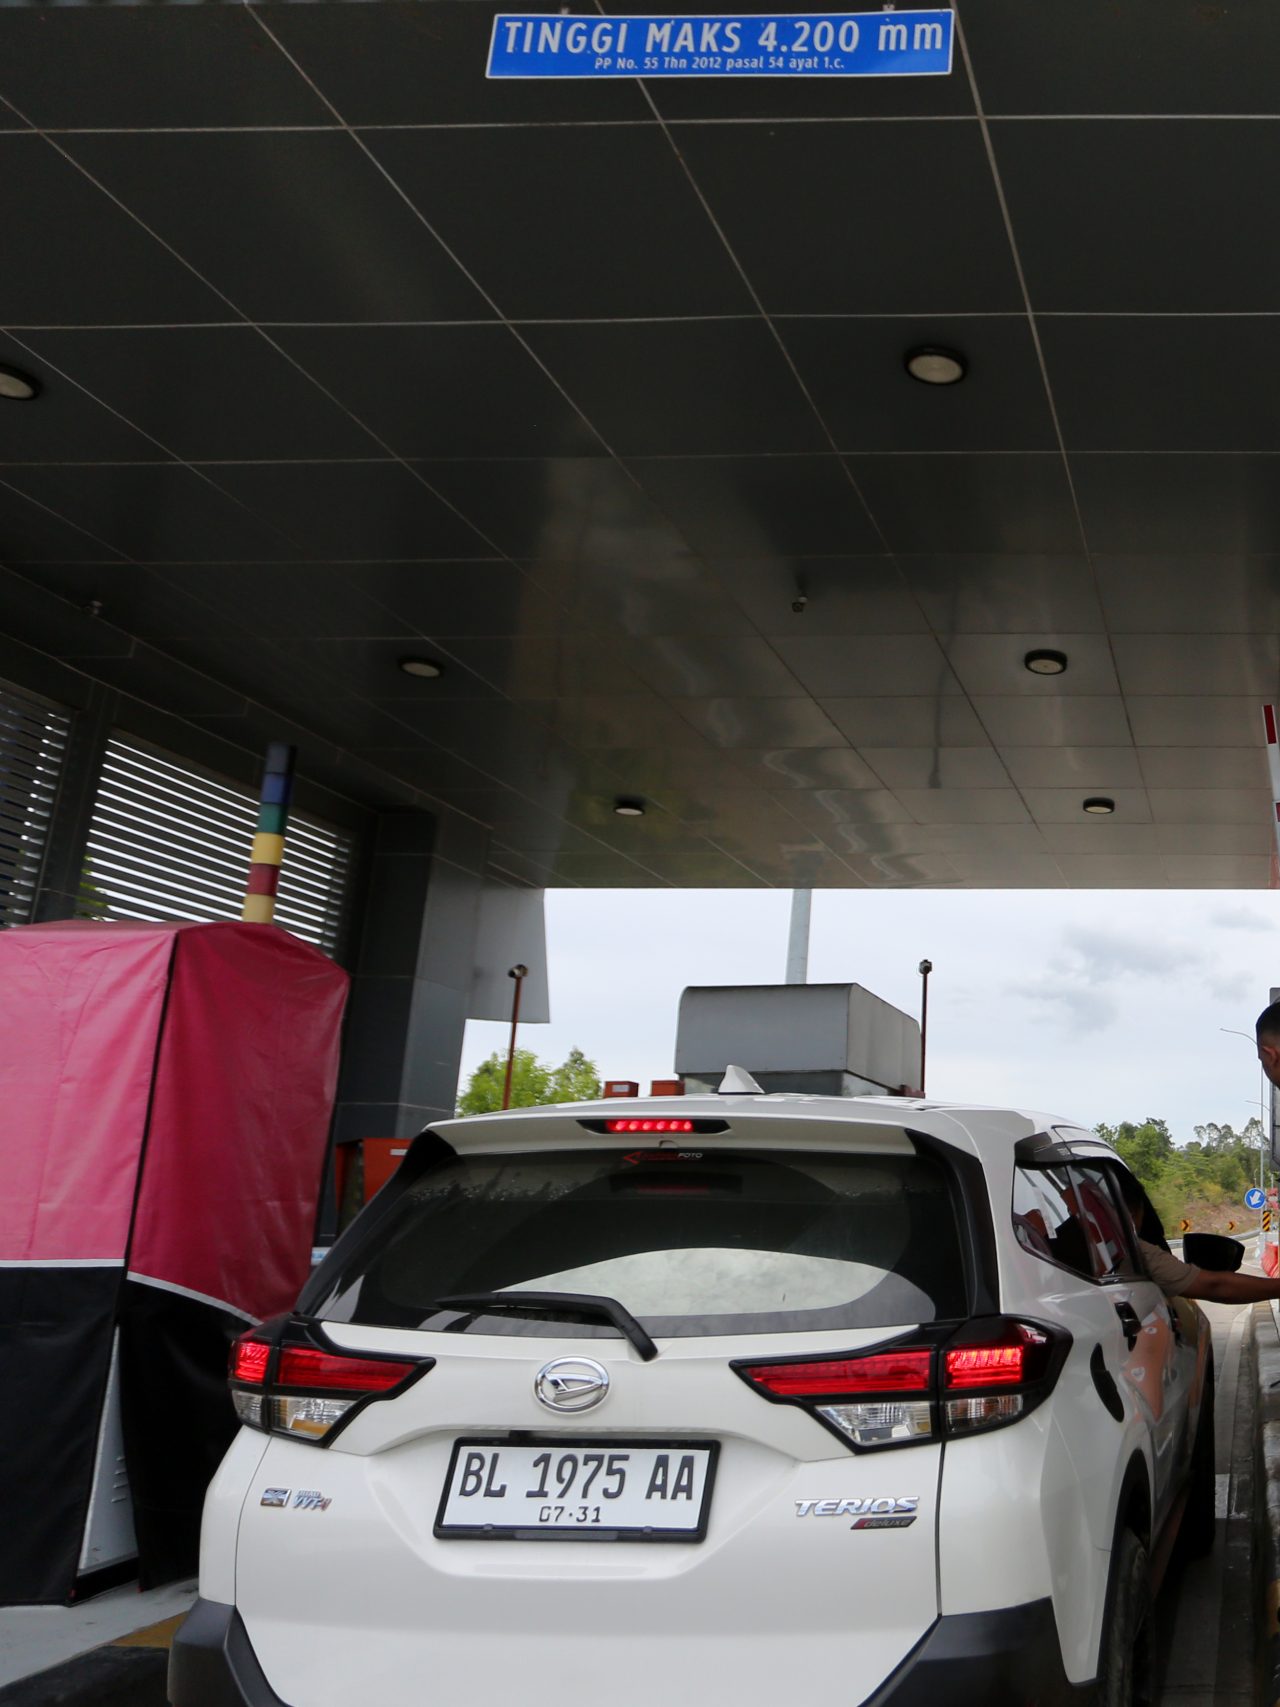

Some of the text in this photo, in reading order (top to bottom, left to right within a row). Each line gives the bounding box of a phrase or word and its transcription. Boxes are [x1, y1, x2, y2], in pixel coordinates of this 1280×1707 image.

[505, 19, 943, 54] TINGGI MAKS 4.200 mm
[595, 57, 612, 69] PP
[616, 57, 638, 69] No.
[643, 57, 659, 69] 55
[663, 56, 687, 69] Thn
[692, 57, 722, 69] 2012
[726, 56, 764, 71] pasal
[768, 56, 784, 69] 54
[789, 57, 818, 71] ayat
[459, 1452, 695, 1501] BL 1975 AA
[795, 1496, 919, 1517] TERIOS
